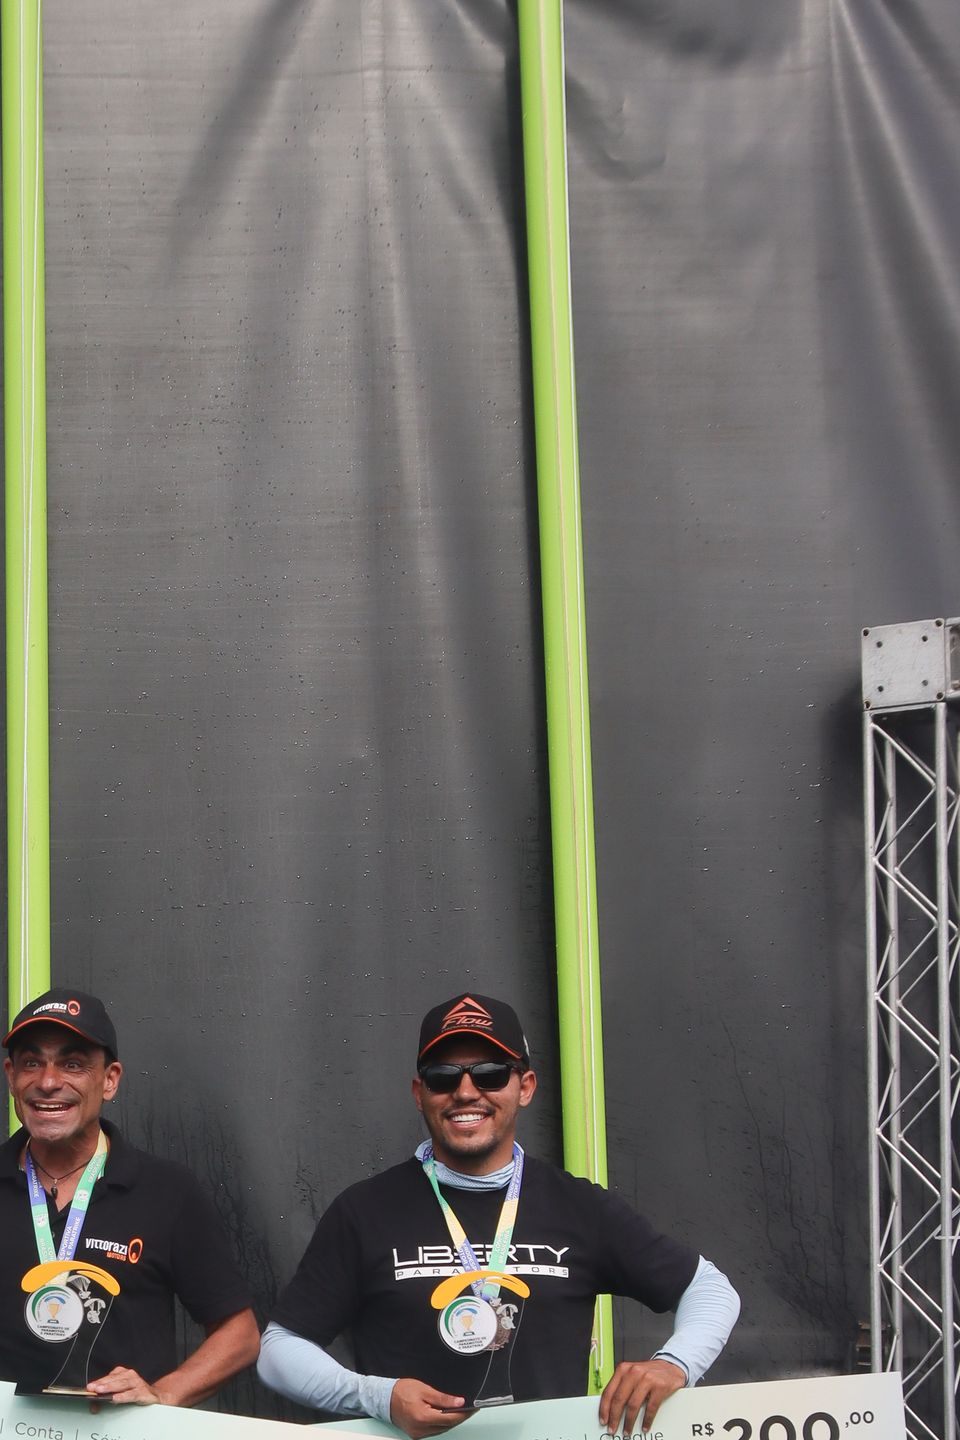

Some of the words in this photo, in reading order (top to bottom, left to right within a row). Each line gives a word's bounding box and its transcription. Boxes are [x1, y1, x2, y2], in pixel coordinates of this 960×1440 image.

[396, 1266, 568, 1279] PARATORS
[13, 1418, 64, 1440] Conta
[691, 1421, 716, 1438] R$
